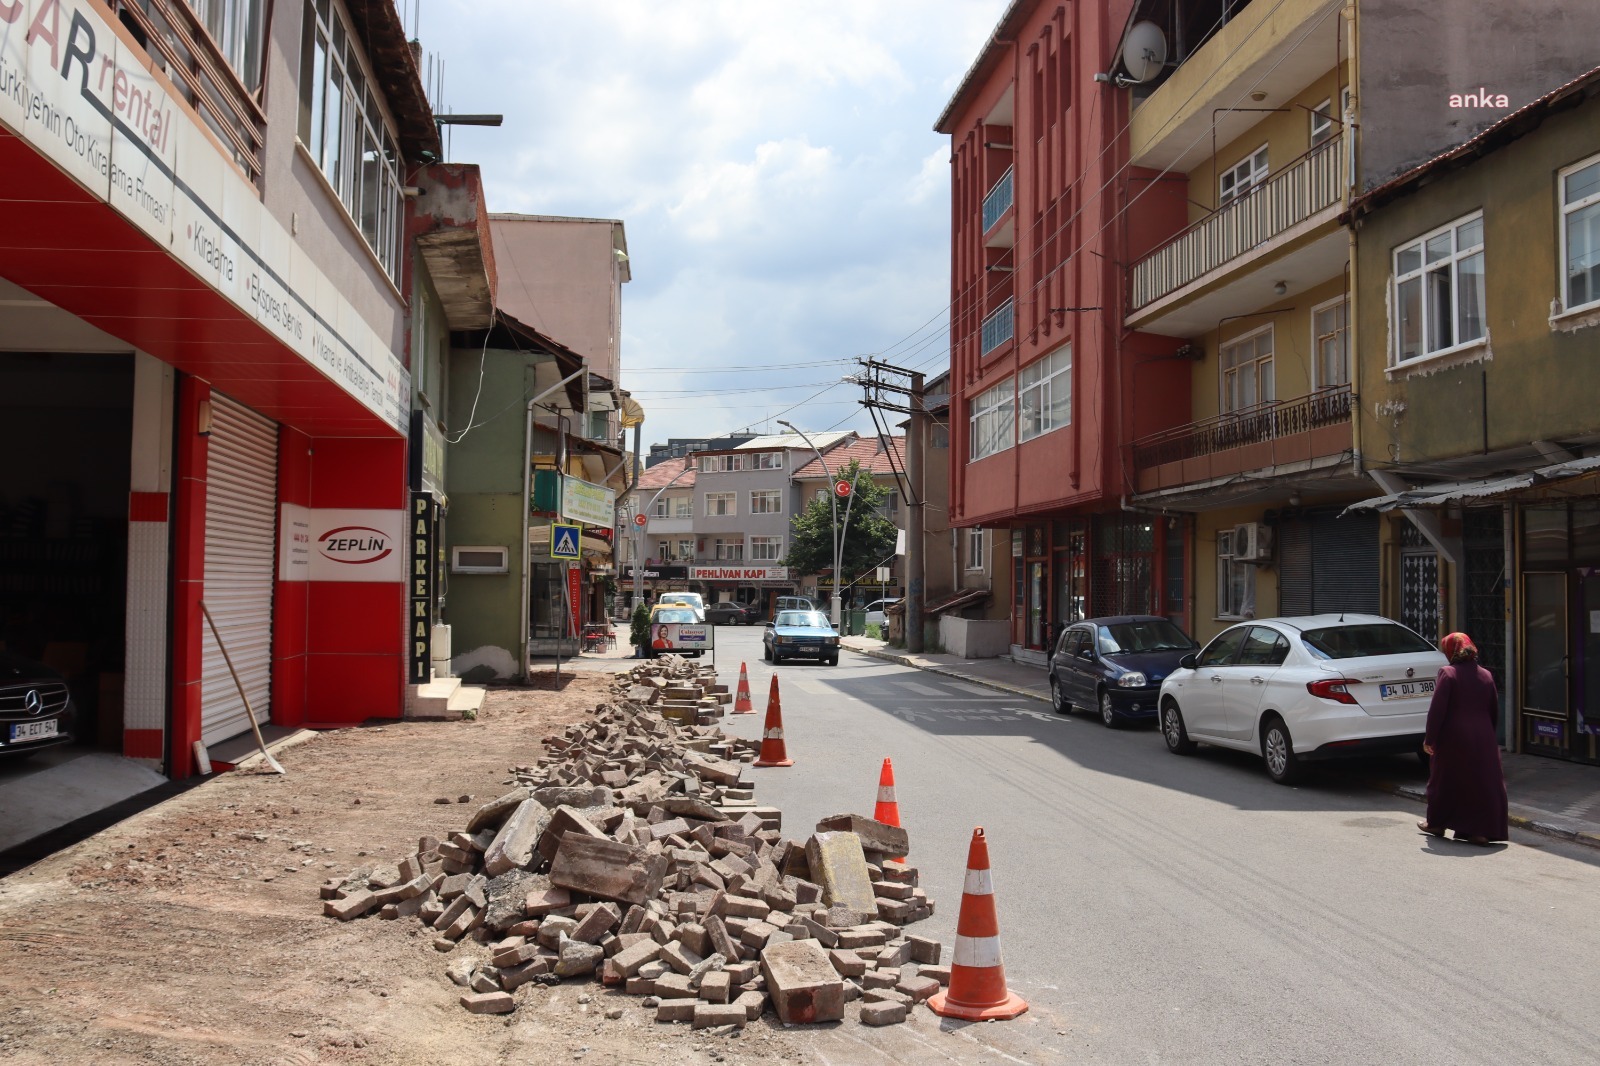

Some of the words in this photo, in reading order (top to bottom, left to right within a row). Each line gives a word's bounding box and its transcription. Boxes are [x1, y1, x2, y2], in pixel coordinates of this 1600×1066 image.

[98, 53, 171, 154] rental
[65, 116, 85, 157] Oto
[87, 135, 132, 197] Kiralama
[194, 221, 233, 282] Kiralama
[251, 273, 280, 322] Ekspres
[282, 302, 303, 340] Servis
[327, 537, 385, 551] ZEPLİN
[416, 499, 427, 595] PARKE
[696, 568, 741, 579] PEHLİVAN
[743, 569, 766, 579] KAPI
[415, 602, 426, 678] KAPI
[1387, 685, 1398, 695] 34
[1402, 684, 1415, 694] DIJ
[1420, 682, 1435, 692] 388
[16, 725, 26, 737] 34
[30, 722, 42, 736] ECT
[1537, 725, 1559, 734] WORLD
